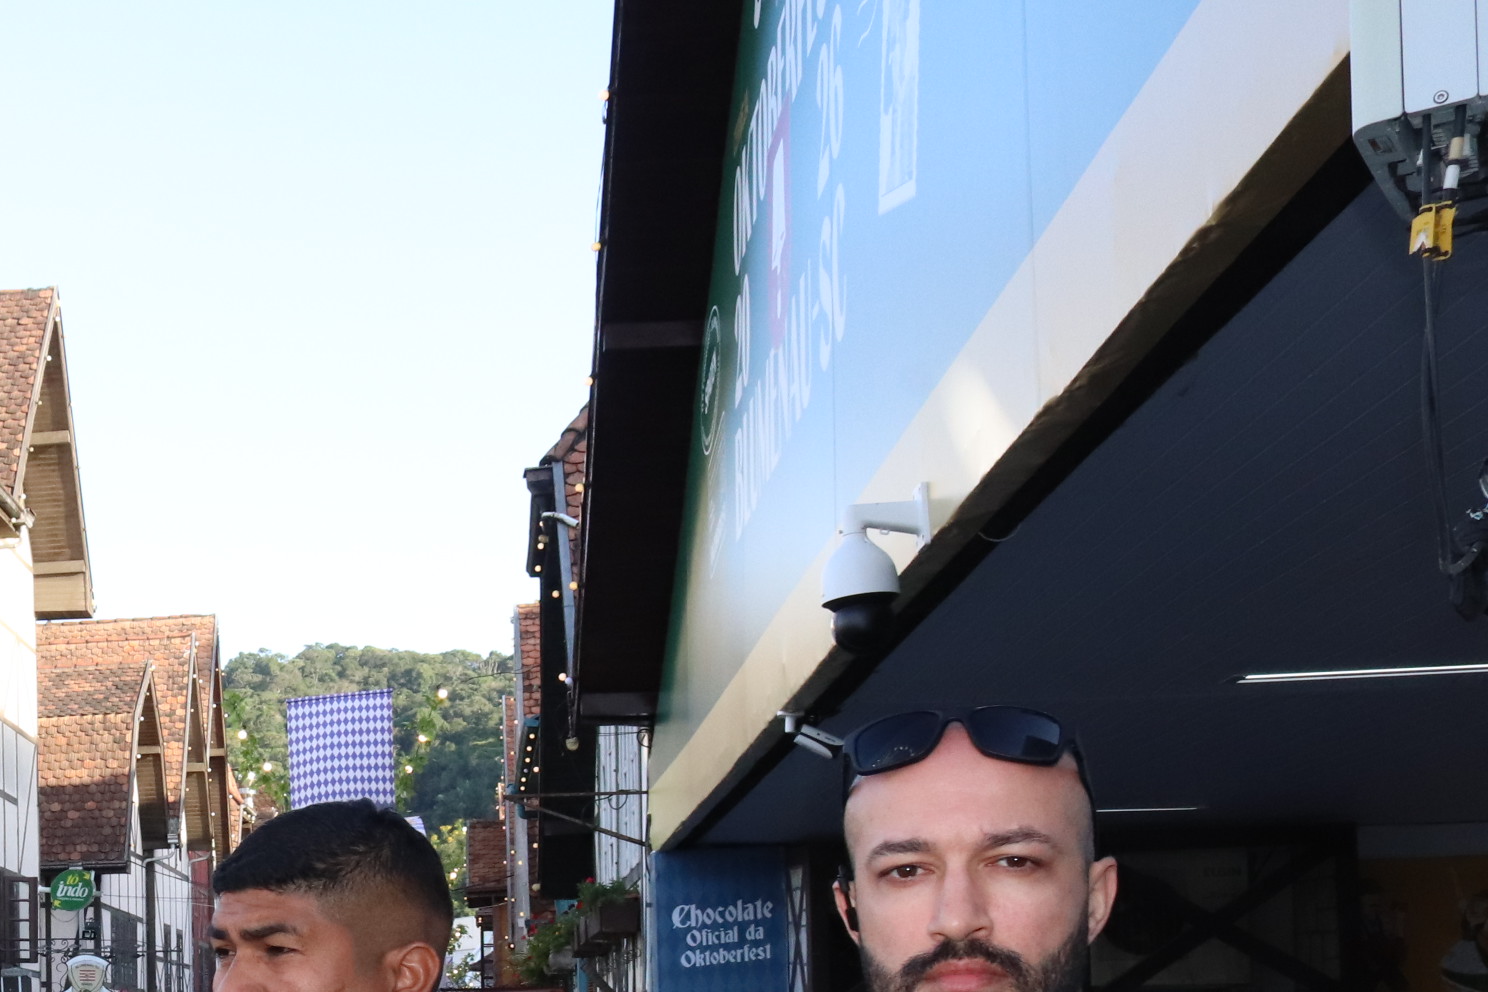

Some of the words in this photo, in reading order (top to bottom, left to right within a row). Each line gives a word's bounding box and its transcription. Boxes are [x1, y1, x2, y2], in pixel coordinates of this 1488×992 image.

[56, 881, 88, 898] indo
[672, 898, 773, 928] Chocolate
[686, 925, 738, 947] Oficial
[746, 924, 764, 940] da
[680, 944, 771, 968] Oktoberfest
